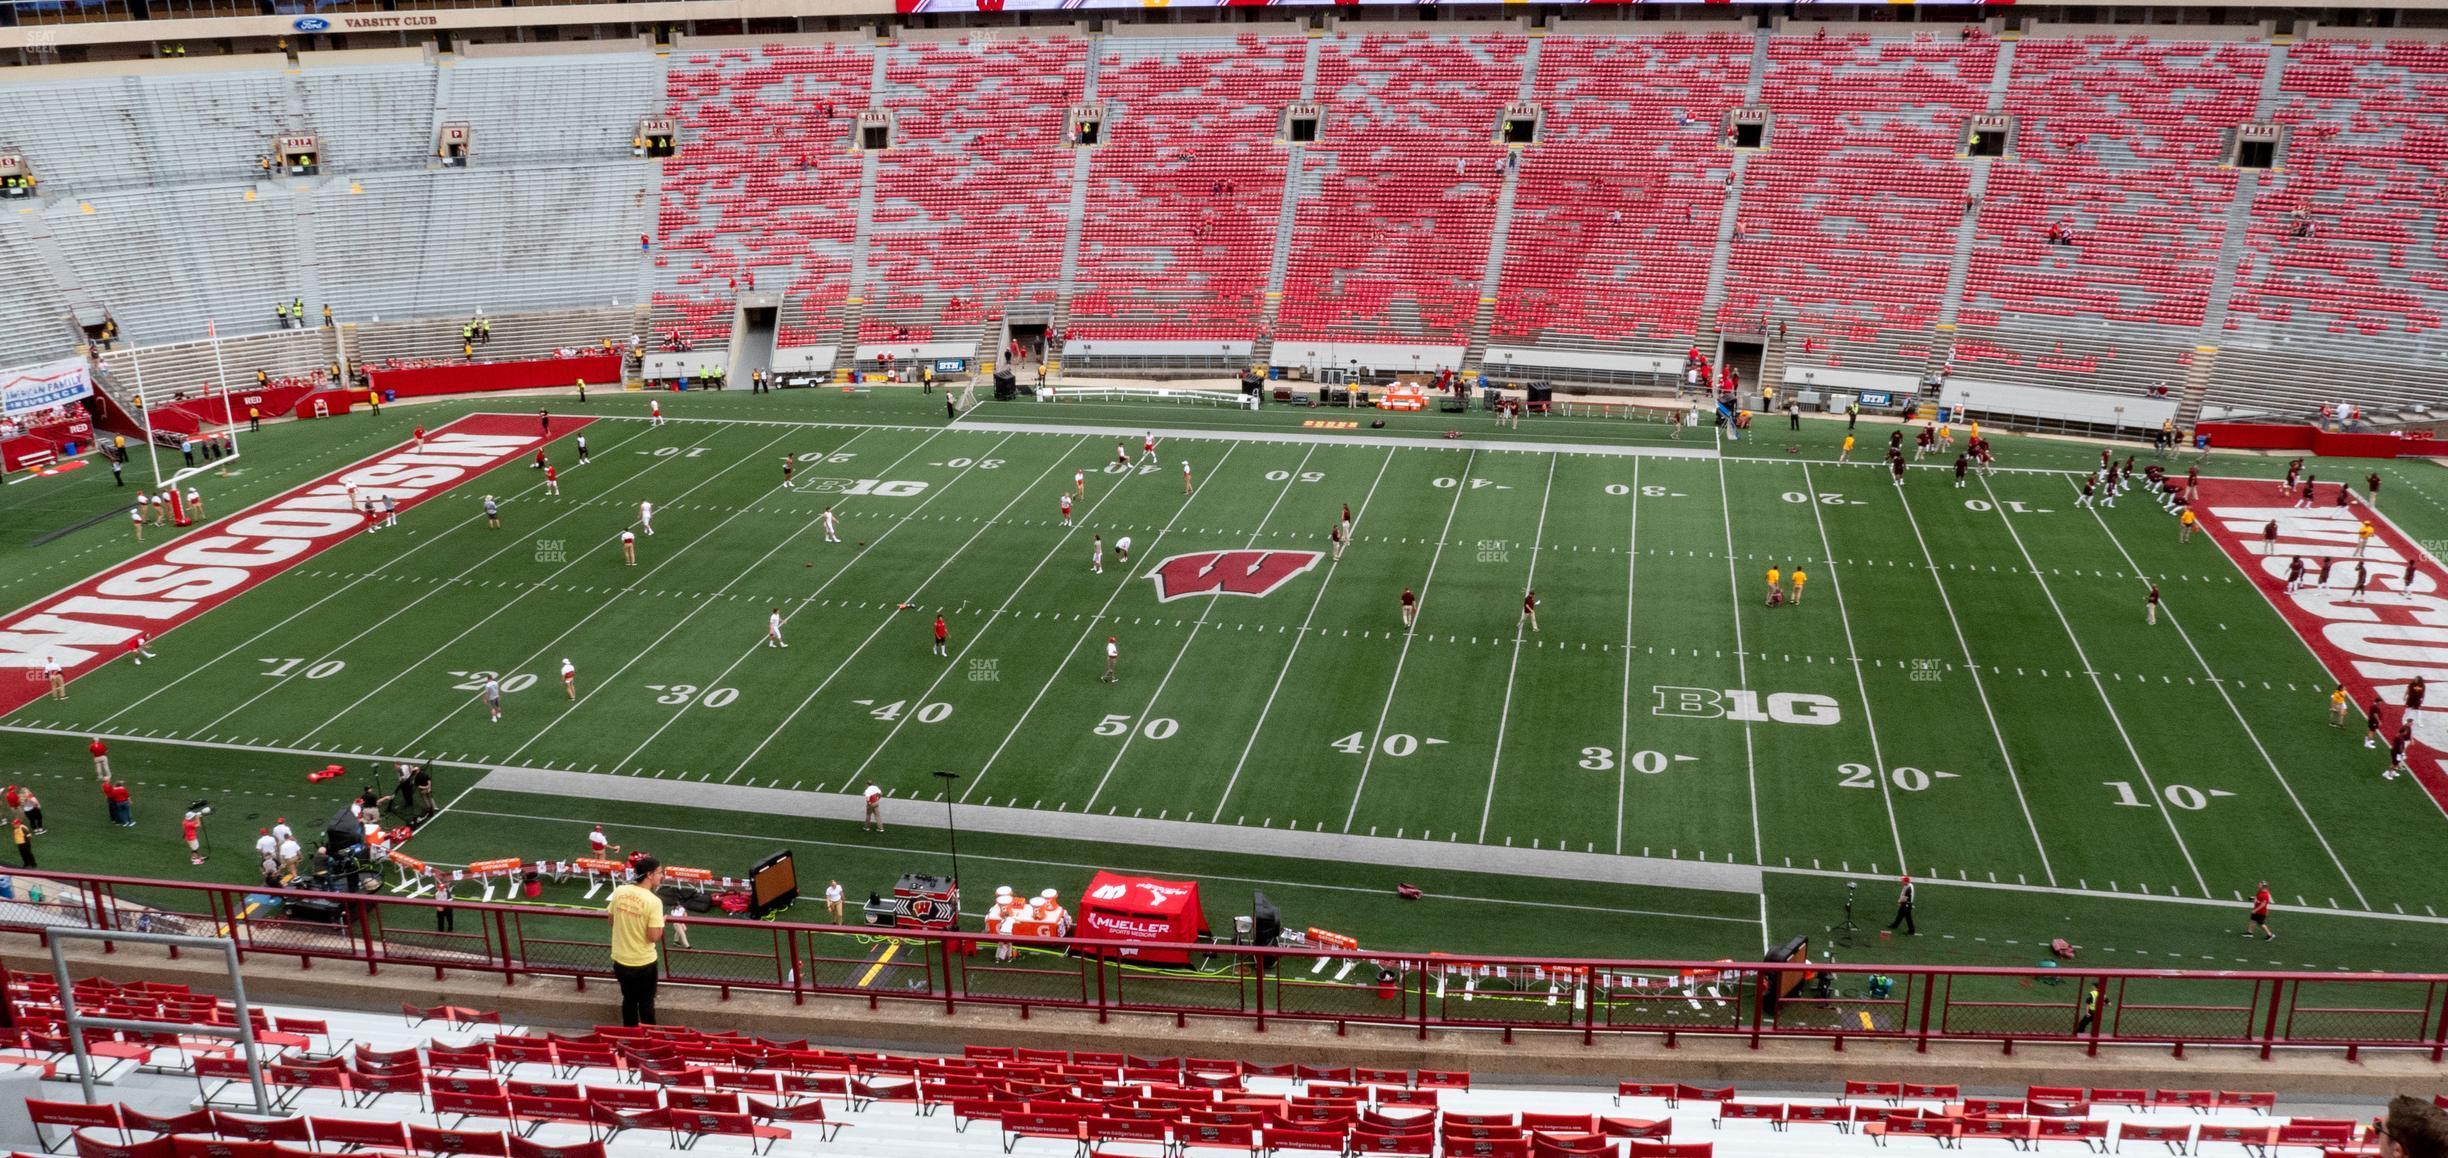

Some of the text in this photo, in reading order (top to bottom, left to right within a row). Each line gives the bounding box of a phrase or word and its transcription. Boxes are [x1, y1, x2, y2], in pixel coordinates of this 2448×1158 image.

[300, 19, 323, 30] Ford
[345, 15, 438, 28] VARSITY CLUB
[939, 361, 960, 370] BTN
[47, 374, 83, 392] FAMILY
[9, 388, 79, 408] INSURANCE
[244, 395, 262, 405] RED
[1862, 394, 1886, 404] BTN
[69, 423, 88, 434] RED
[0, 432, 542, 669] WISCONSIN
[1140, 548, 1327, 603] W
[260, 658, 346, 679] 10
[451, 670, 538, 692] 20
[656, 684, 739, 708] 30
[869, 699, 953, 723] 40
[1093, 714, 1179, 740] 50
[1331, 731, 1418, 757] 40
[1579, 746, 1668, 774] 30
[1837, 763, 1930, 791] 20
[2102, 781, 2207, 810] 10
[912, 901, 932, 917] W
[1096, 917, 1170, 933] MUELLER
[1109, 928, 1131, 936] SPORTS
[1012, 1124, 1070, 1133] www.badgerseats.com
